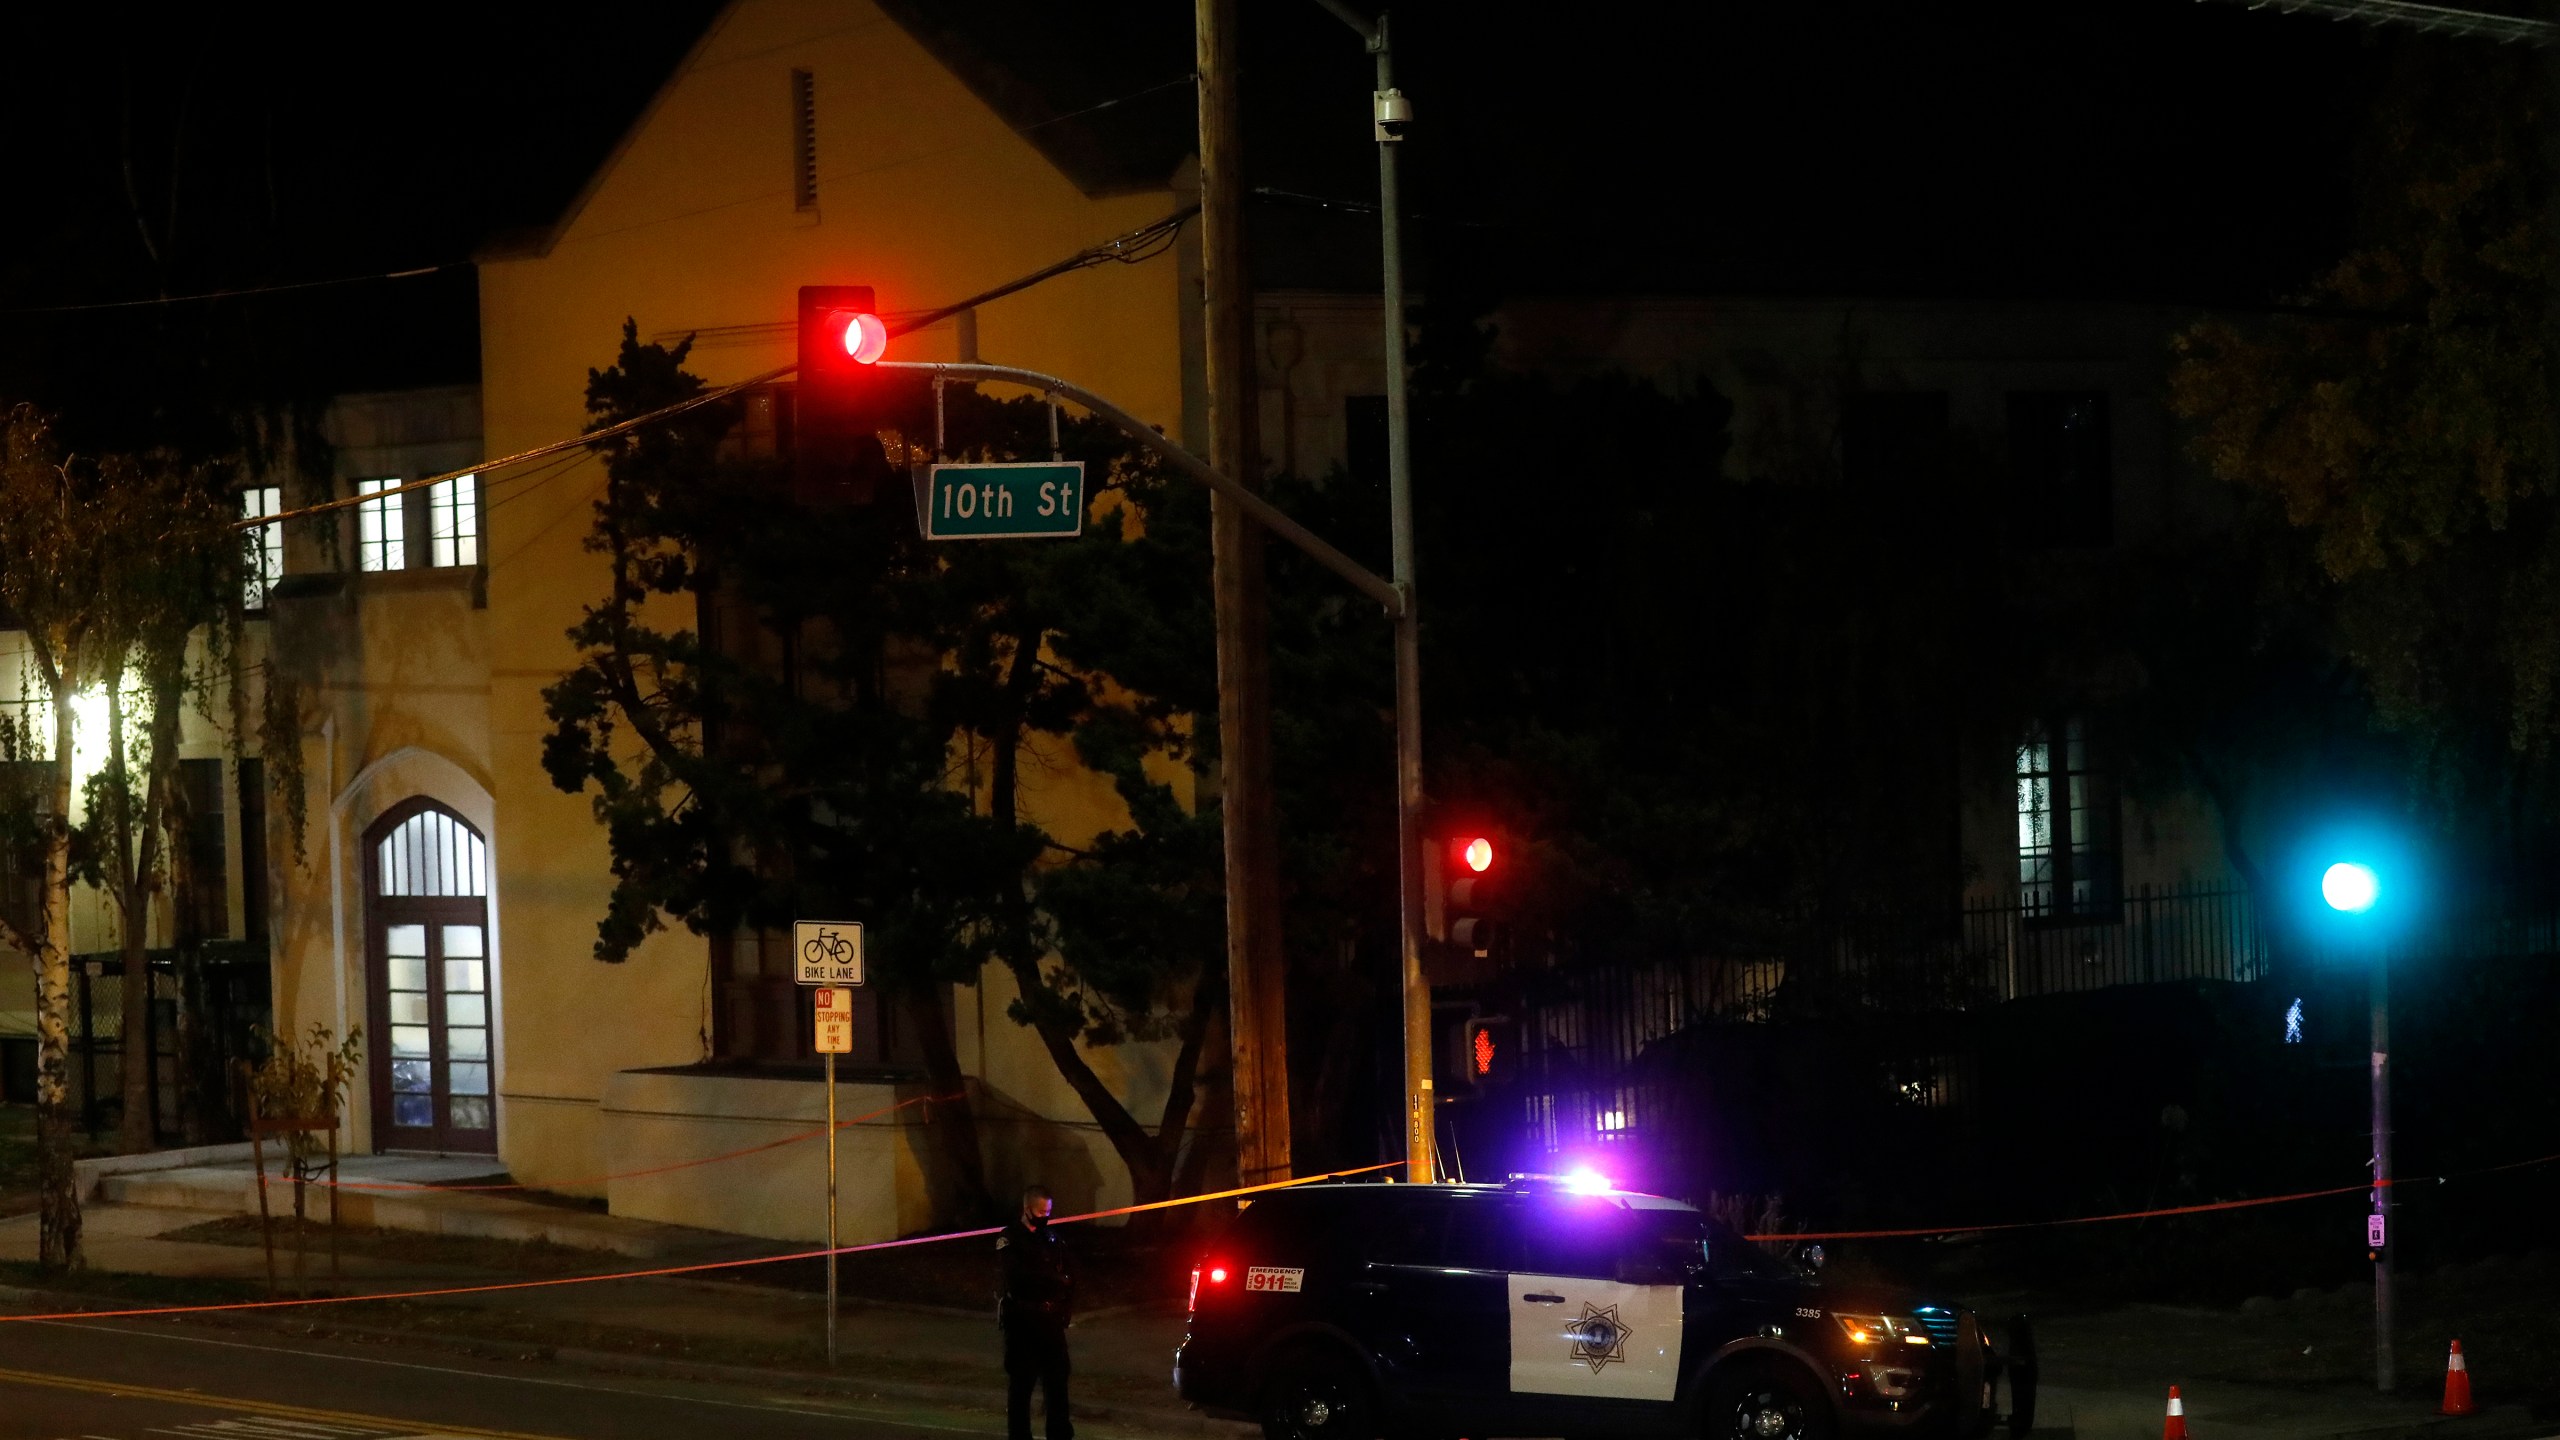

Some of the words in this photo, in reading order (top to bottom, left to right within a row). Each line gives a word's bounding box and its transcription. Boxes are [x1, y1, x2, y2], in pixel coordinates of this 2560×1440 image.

[943, 482, 1013, 519] 10th
[1036, 481, 1073, 517] St
[805, 966, 825, 978] BIKE
[830, 967, 854, 979] LANE
[818, 991, 831, 1006] NO
[817, 1011, 850, 1022] STOPPING
[827, 1024, 840, 1033] ANY
[827, 1035, 841, 1045] TIME
[1250, 1267, 1302, 1275] EMERGENCY
[1795, 1307, 1821, 1319] 3385
